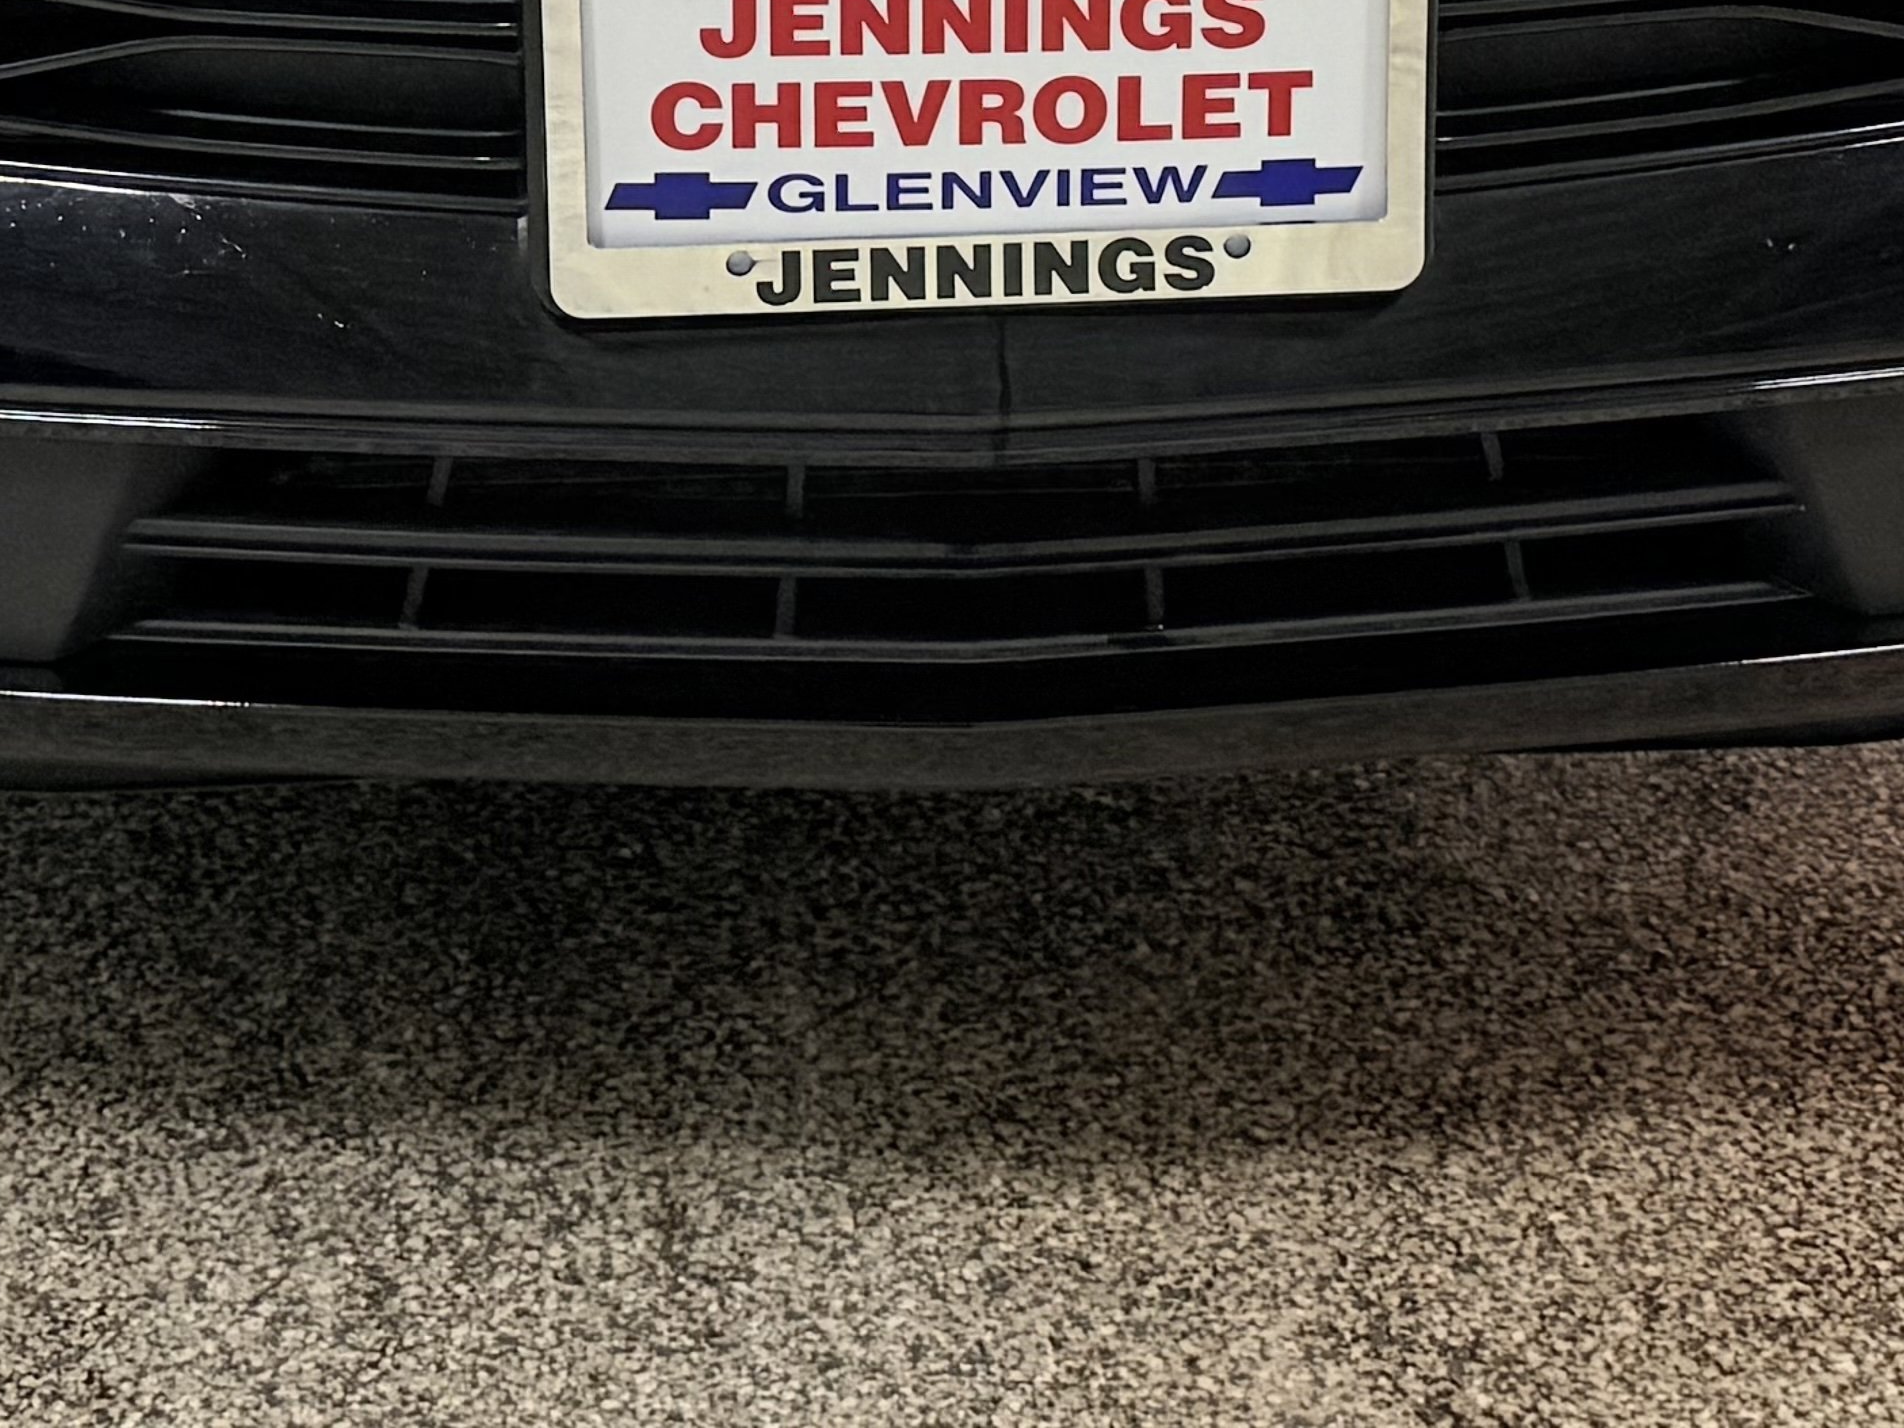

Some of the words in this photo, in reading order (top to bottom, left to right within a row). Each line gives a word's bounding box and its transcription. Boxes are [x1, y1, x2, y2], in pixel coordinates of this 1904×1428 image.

[650, 70, 1314, 152] CHEVROLET
[767, 164, 1209, 214] GLENVIEW
[755, 235, 1216, 307] JENNINGS
